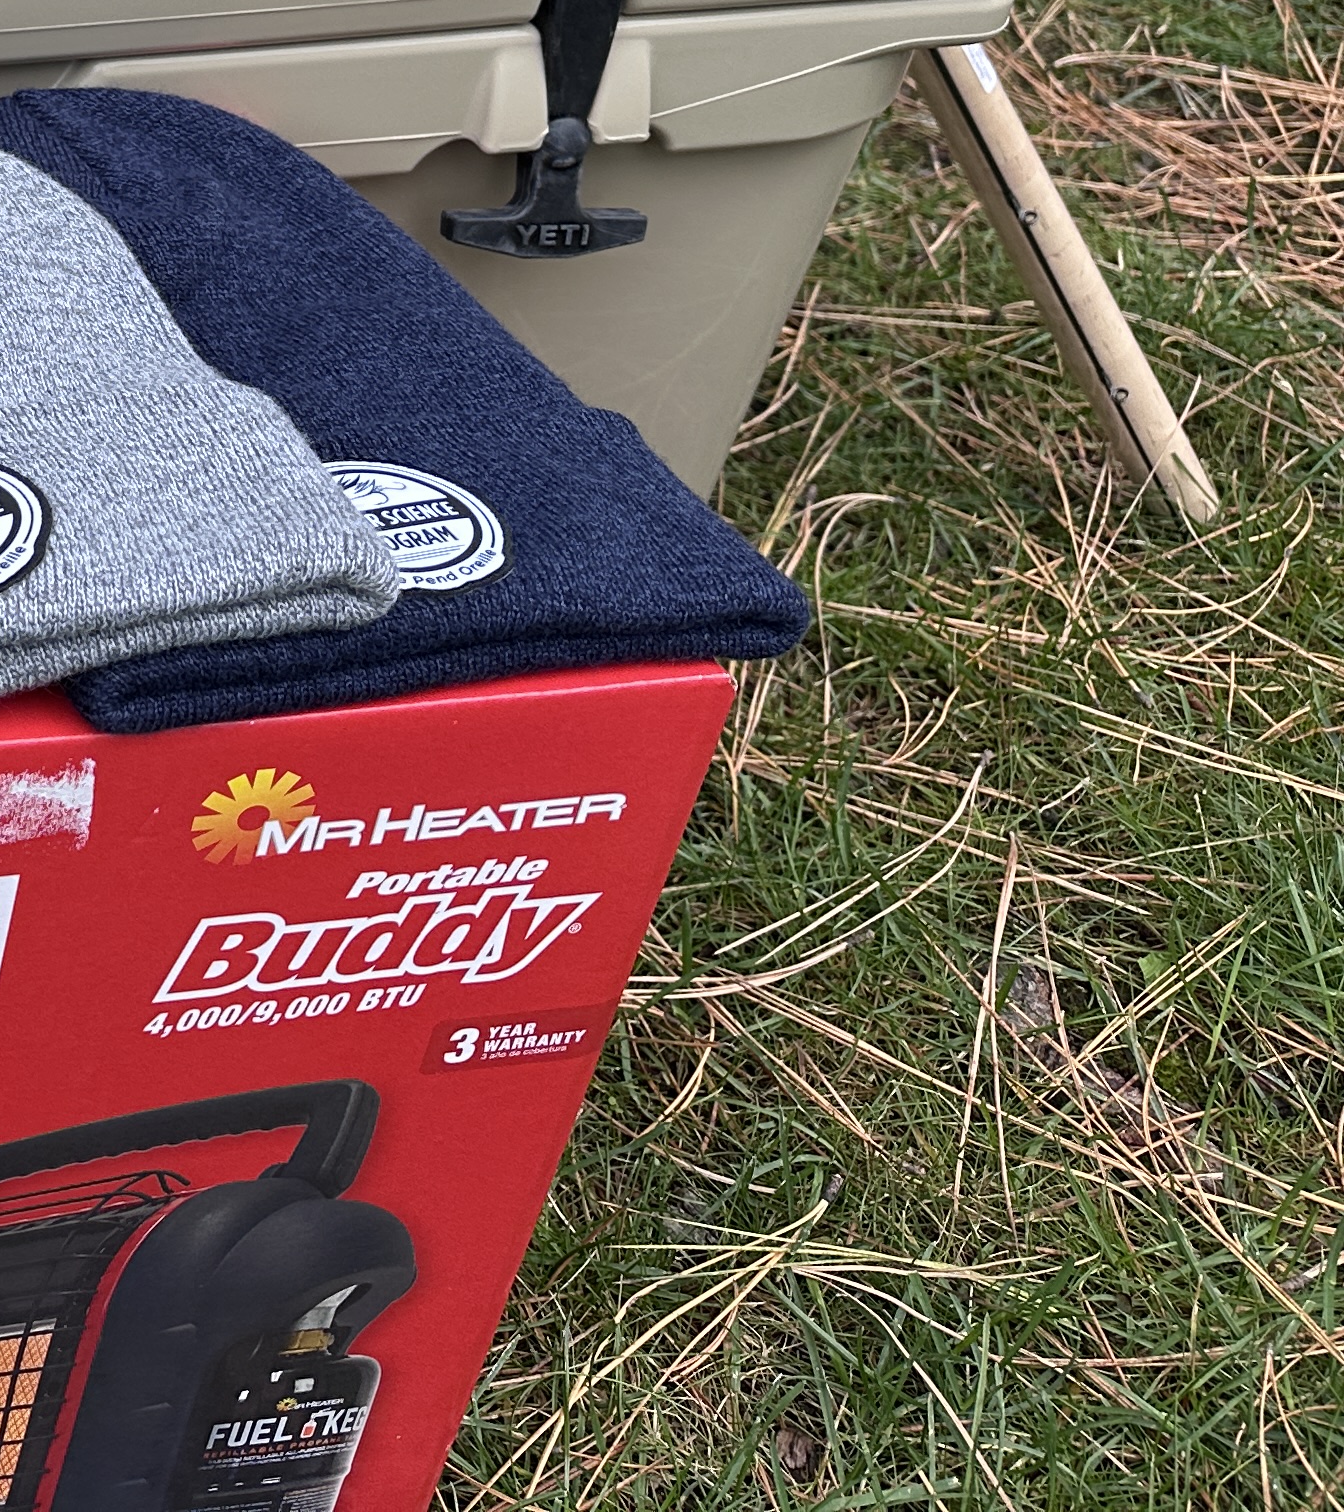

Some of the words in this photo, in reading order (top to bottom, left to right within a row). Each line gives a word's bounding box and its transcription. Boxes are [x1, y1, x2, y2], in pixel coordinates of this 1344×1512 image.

[516, 222, 590, 247] YETI
[384, 501, 459, 526] SCIENCE
[413, 571, 458, 585] Pend
[461, 549, 496, 575] Oreille
[255, 815, 366, 858] MR
[370, 792, 627, 846] HEATER
[346, 856, 549, 899] Portable
[152, 884, 603, 1004] Buddy
[142, 992, 350, 1038] 4,000/9,000
[358, 984, 426, 1012] BTU
[444, 1027, 480, 1064] 3
[489, 1022, 536, 1039] YEAR
[484, 1030, 586, 1052] WARRANTY
[206, 1416, 292, 1450] FUEL
[322, 1406, 368, 1436] KEG
